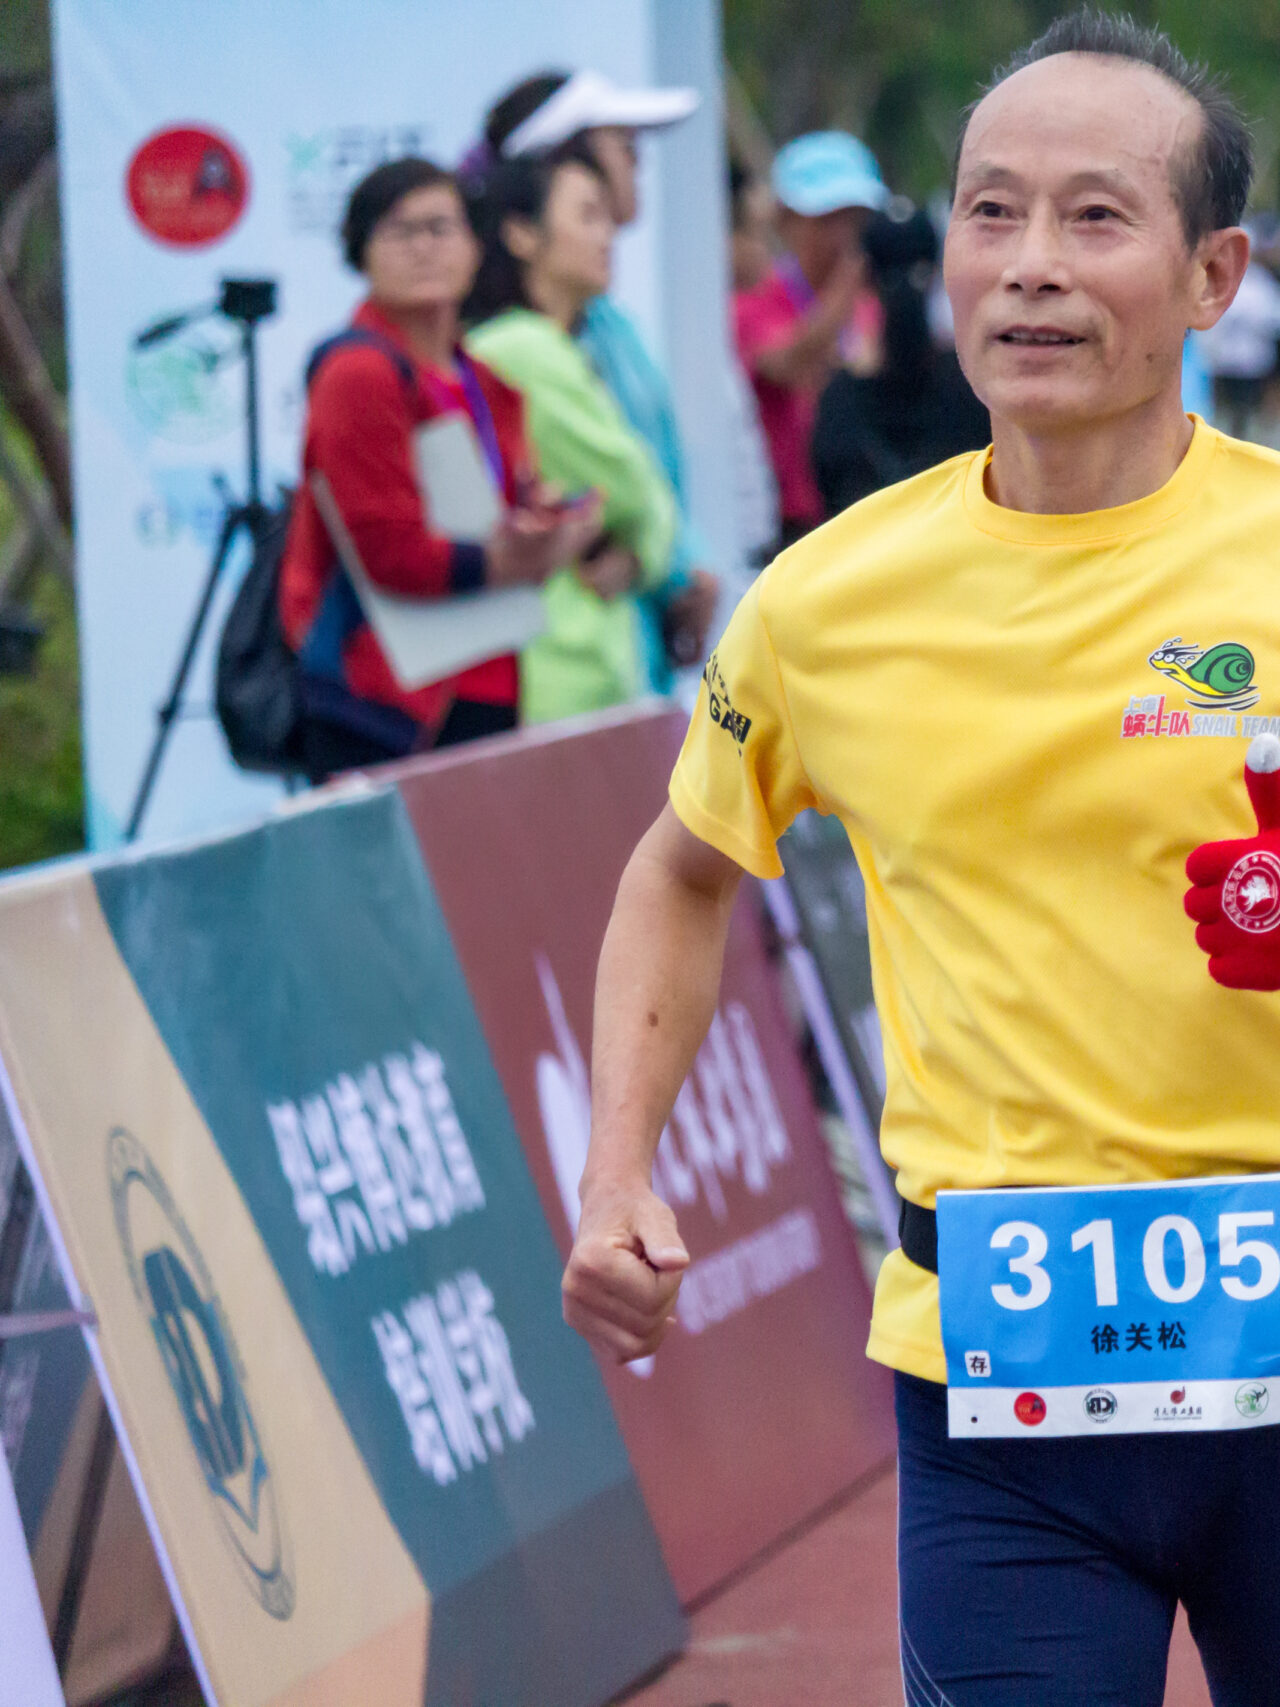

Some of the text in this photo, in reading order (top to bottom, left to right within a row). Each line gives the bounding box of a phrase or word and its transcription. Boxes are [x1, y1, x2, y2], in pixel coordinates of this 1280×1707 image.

[1122, 697, 1190, 737] 蜗牛队
[1191, 714, 1237, 737] SNAIL
[1090, 1321, 1188, 1355] 徐关松
[969, 1354, 988, 1375] 存
